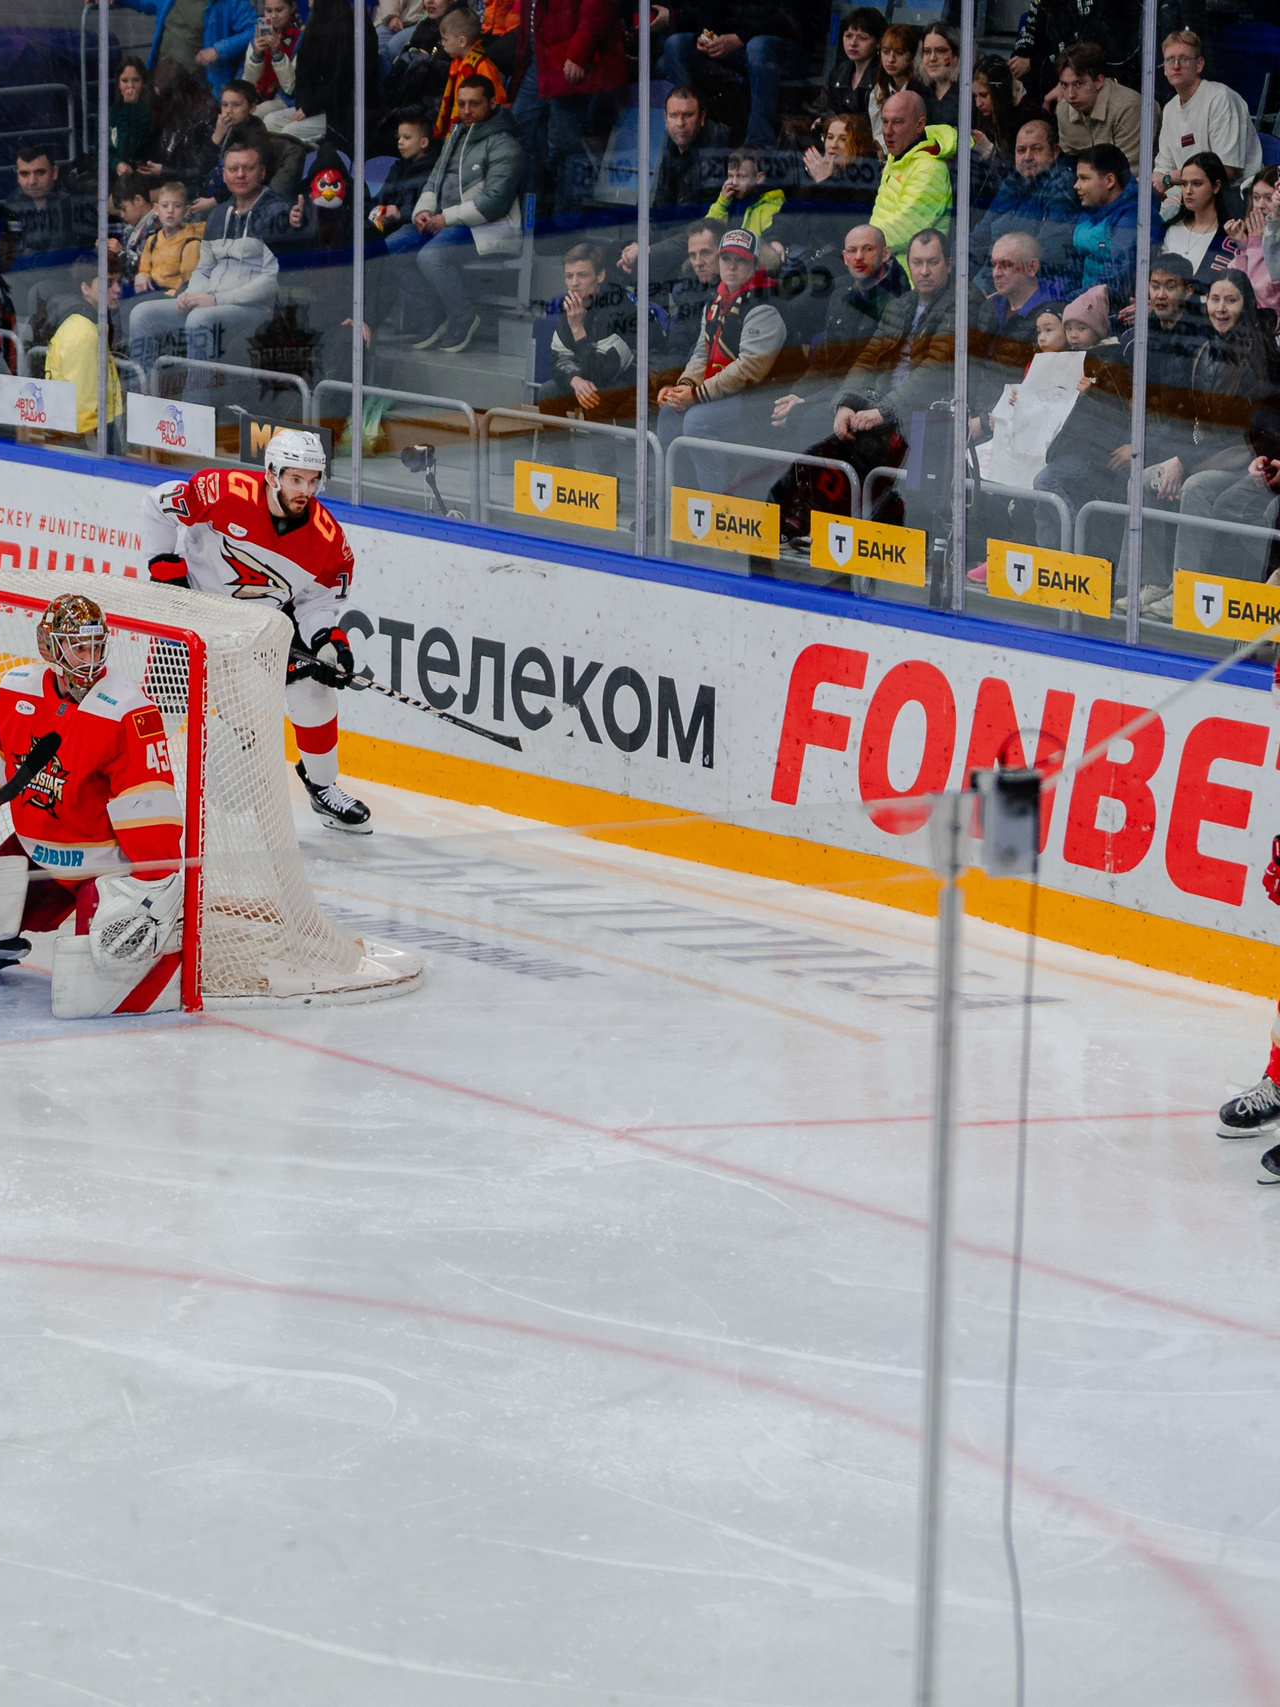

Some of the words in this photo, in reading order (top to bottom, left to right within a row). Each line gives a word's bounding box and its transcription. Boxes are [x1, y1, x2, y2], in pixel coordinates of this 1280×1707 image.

[14, 398, 36, 411] АВТО
[20, 409, 47, 423] РАДИО
[156, 420, 176, 433] АВТО
[161, 432, 187, 447] РАДИО
[160, 486, 189, 518] 17
[536, 482, 546, 499] Т
[556, 486, 600, 510] БАНК
[39, 515, 142, 551] #UNITEDWEWIN
[694, 509, 705, 527] Т
[715, 513, 762, 538] БАНК
[835, 535, 846, 553] Т
[858, 539, 906, 565] БАНК
[1013, 563, 1026, 582] Т
[1037, 568, 1090, 595] БАНК
[1202, 595, 1215, 614] Т
[1228, 599, 1280, 625] БАНК
[335, 608, 715, 769] стелеком
[146, 738, 169, 774] 45
[771, 643, 1280, 906] FONBE
[31, 845, 84, 867] SIBUR
